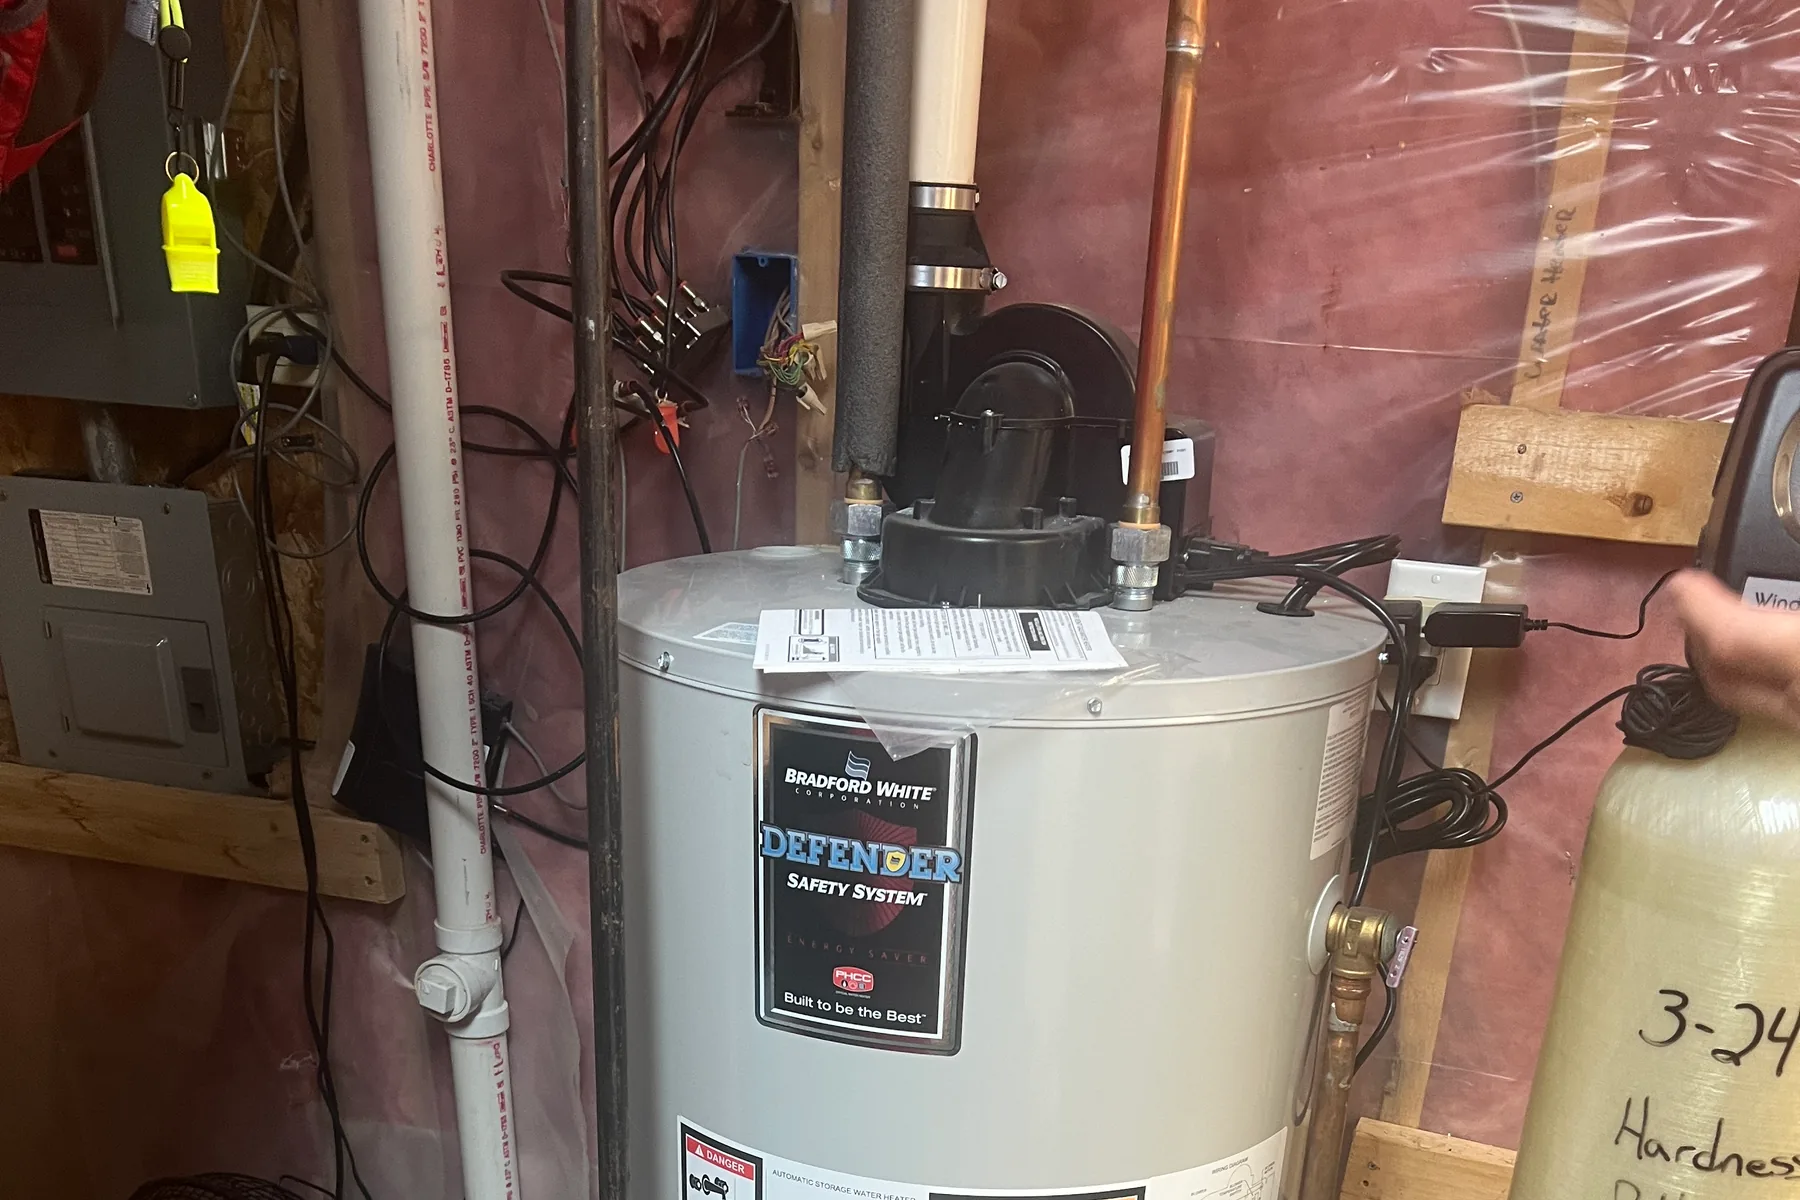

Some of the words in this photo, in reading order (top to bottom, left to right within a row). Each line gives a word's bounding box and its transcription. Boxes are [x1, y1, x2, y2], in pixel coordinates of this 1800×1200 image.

[425, 113, 436, 172] CHARLOTTE
[785, 768, 872, 795] BRADFORD
[795, 788, 919, 810] CORPORATION
[477, 811, 487, 855] CHARLOTTE
[760, 821, 962, 884] DEFENDER
[787, 873, 850, 896] SAFETY
[787, 934, 854, 954] ENERGY
[869, 950, 928, 964] SAVER
[835, 970, 872, 983] PHCC
[784, 992, 814, 1008] Built
[817, 999, 832, 1012] to
[835, 1002, 854, 1015] be
[857, 1006, 882, 1020] the
[706, 1151, 745, 1174] DANGER
[772, 1169, 814, 1186] AUTOMATIC
[815, 1181, 852, 1194] STORAGE
[853, 1188, 882, 1200] WATER
